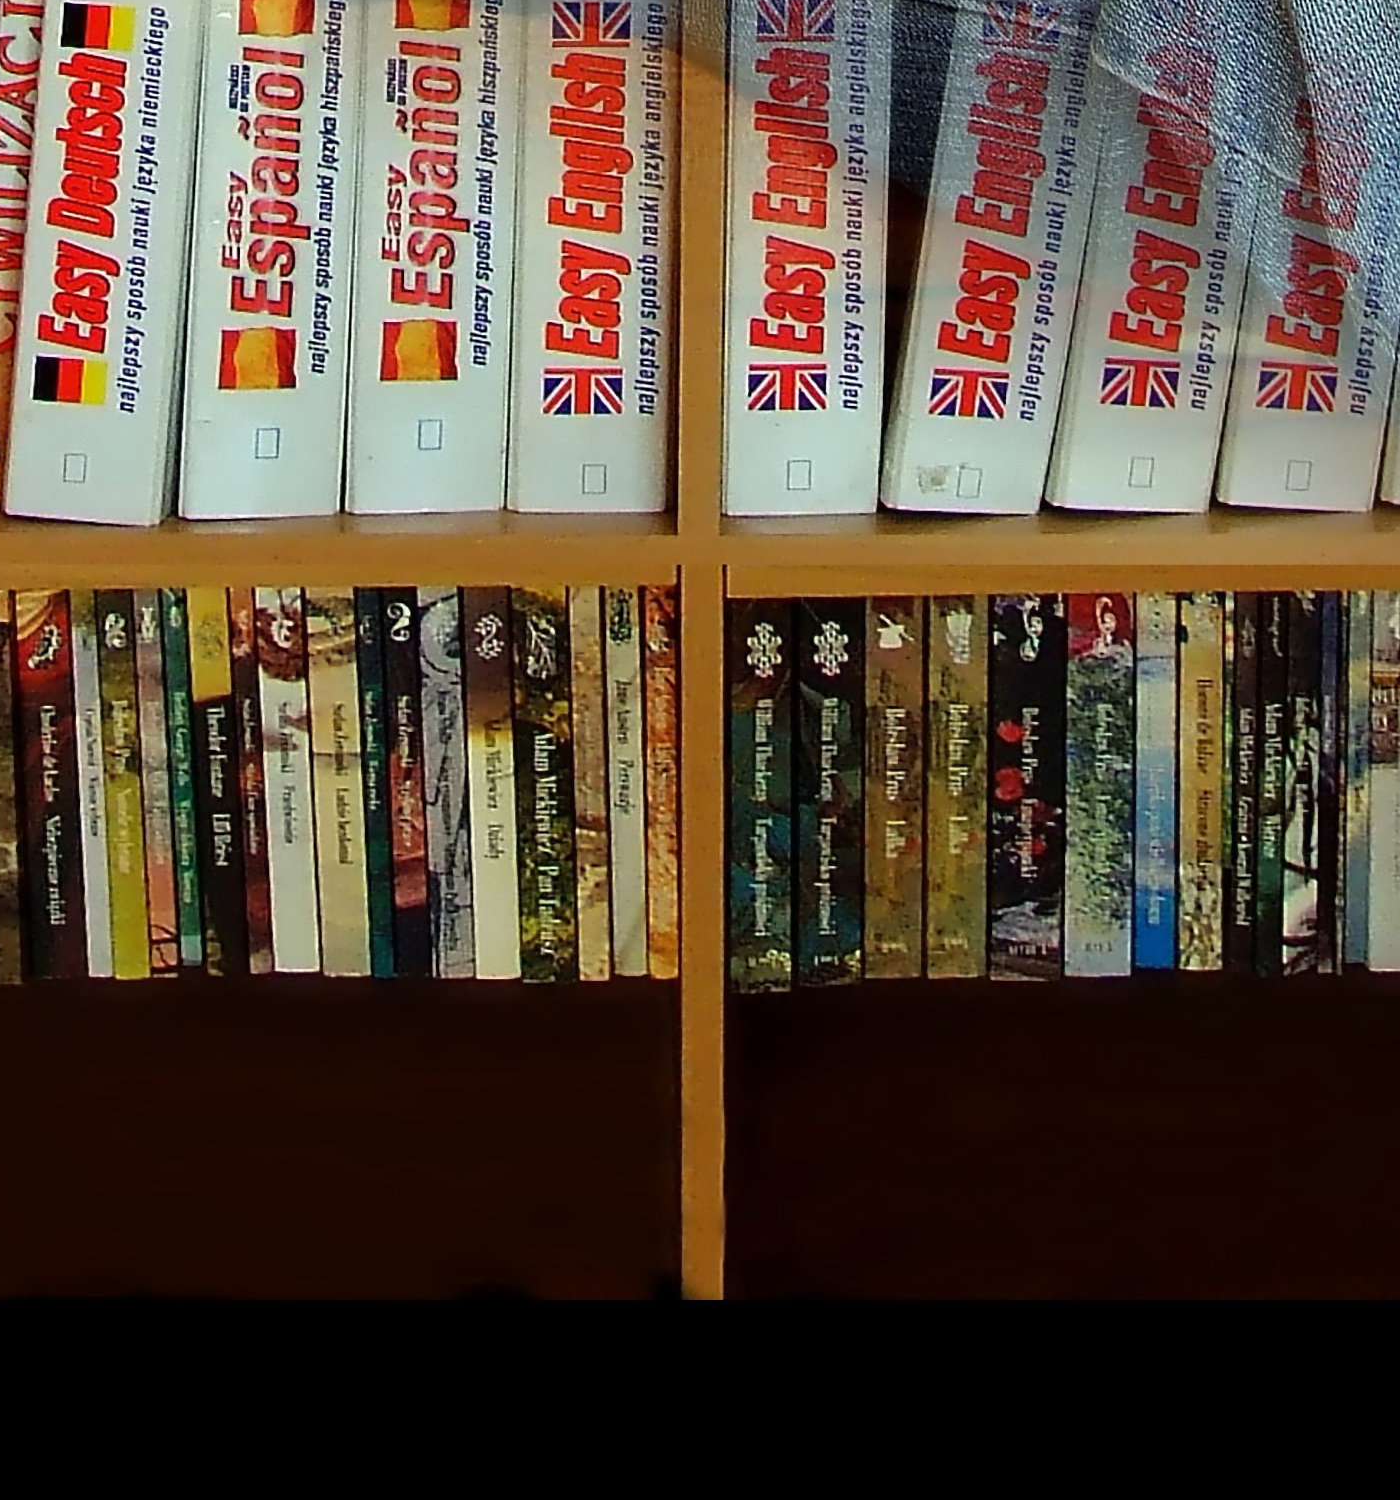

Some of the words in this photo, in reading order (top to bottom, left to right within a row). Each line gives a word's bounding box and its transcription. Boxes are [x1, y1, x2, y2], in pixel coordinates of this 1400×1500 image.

[137, 6, 169, 126] niemieckiego
[47, 52, 128, 239] Deutsch
[135, 127, 158, 194] języka
[232, 47, 311, 318] Español
[394, 40, 471, 311] Español
[548, 50, 637, 233] English
[753, 45, 840, 232] English
[956, 45, 1059, 237] English
[132, 197, 153, 251] nauki
[222, 169, 247, 271] Easy
[383, 161, 408, 263] Easy
[38, 240, 122, 354] Easy
[126, 254, 148, 321] sposób
[545, 240, 633, 361] Easy
[750, 235, 838, 357] Easy
[940, 240, 1034, 363] Easy
[118, 321, 146, 413] najlepszy
